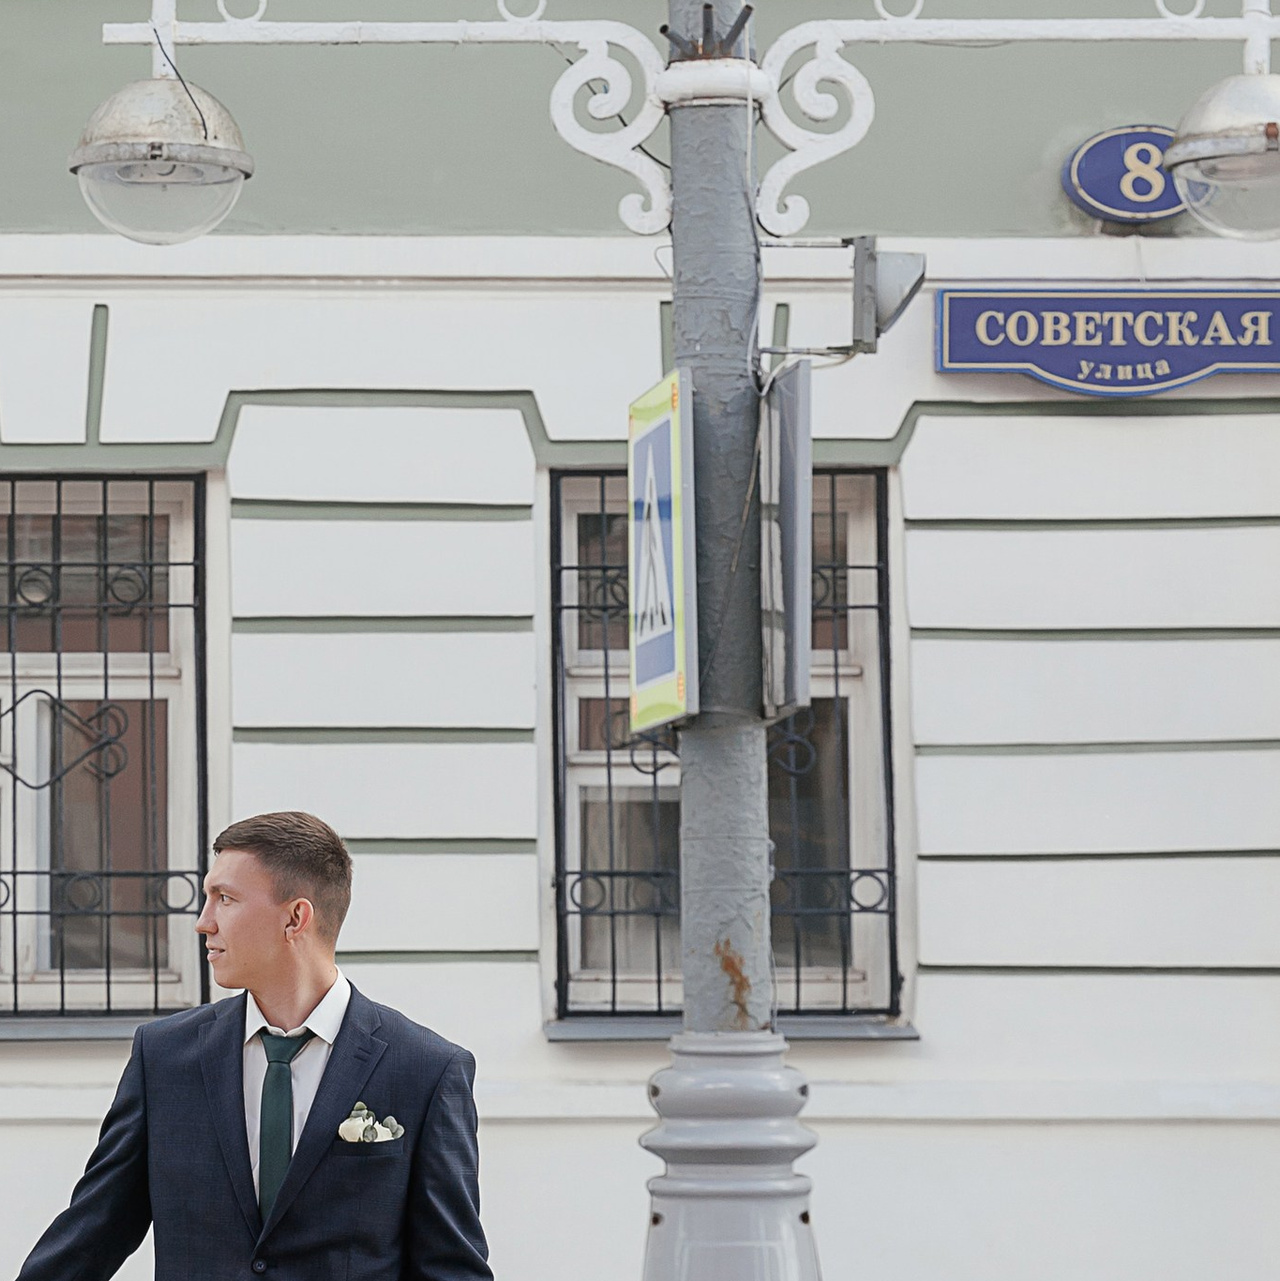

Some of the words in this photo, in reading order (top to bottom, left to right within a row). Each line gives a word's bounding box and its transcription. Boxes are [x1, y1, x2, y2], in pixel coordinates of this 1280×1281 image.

[1120, 142, 1166, 203] 8
[976, 310, 1273, 347] СОВЕТСКАЯ
[1077, 359, 1171, 381] улица
